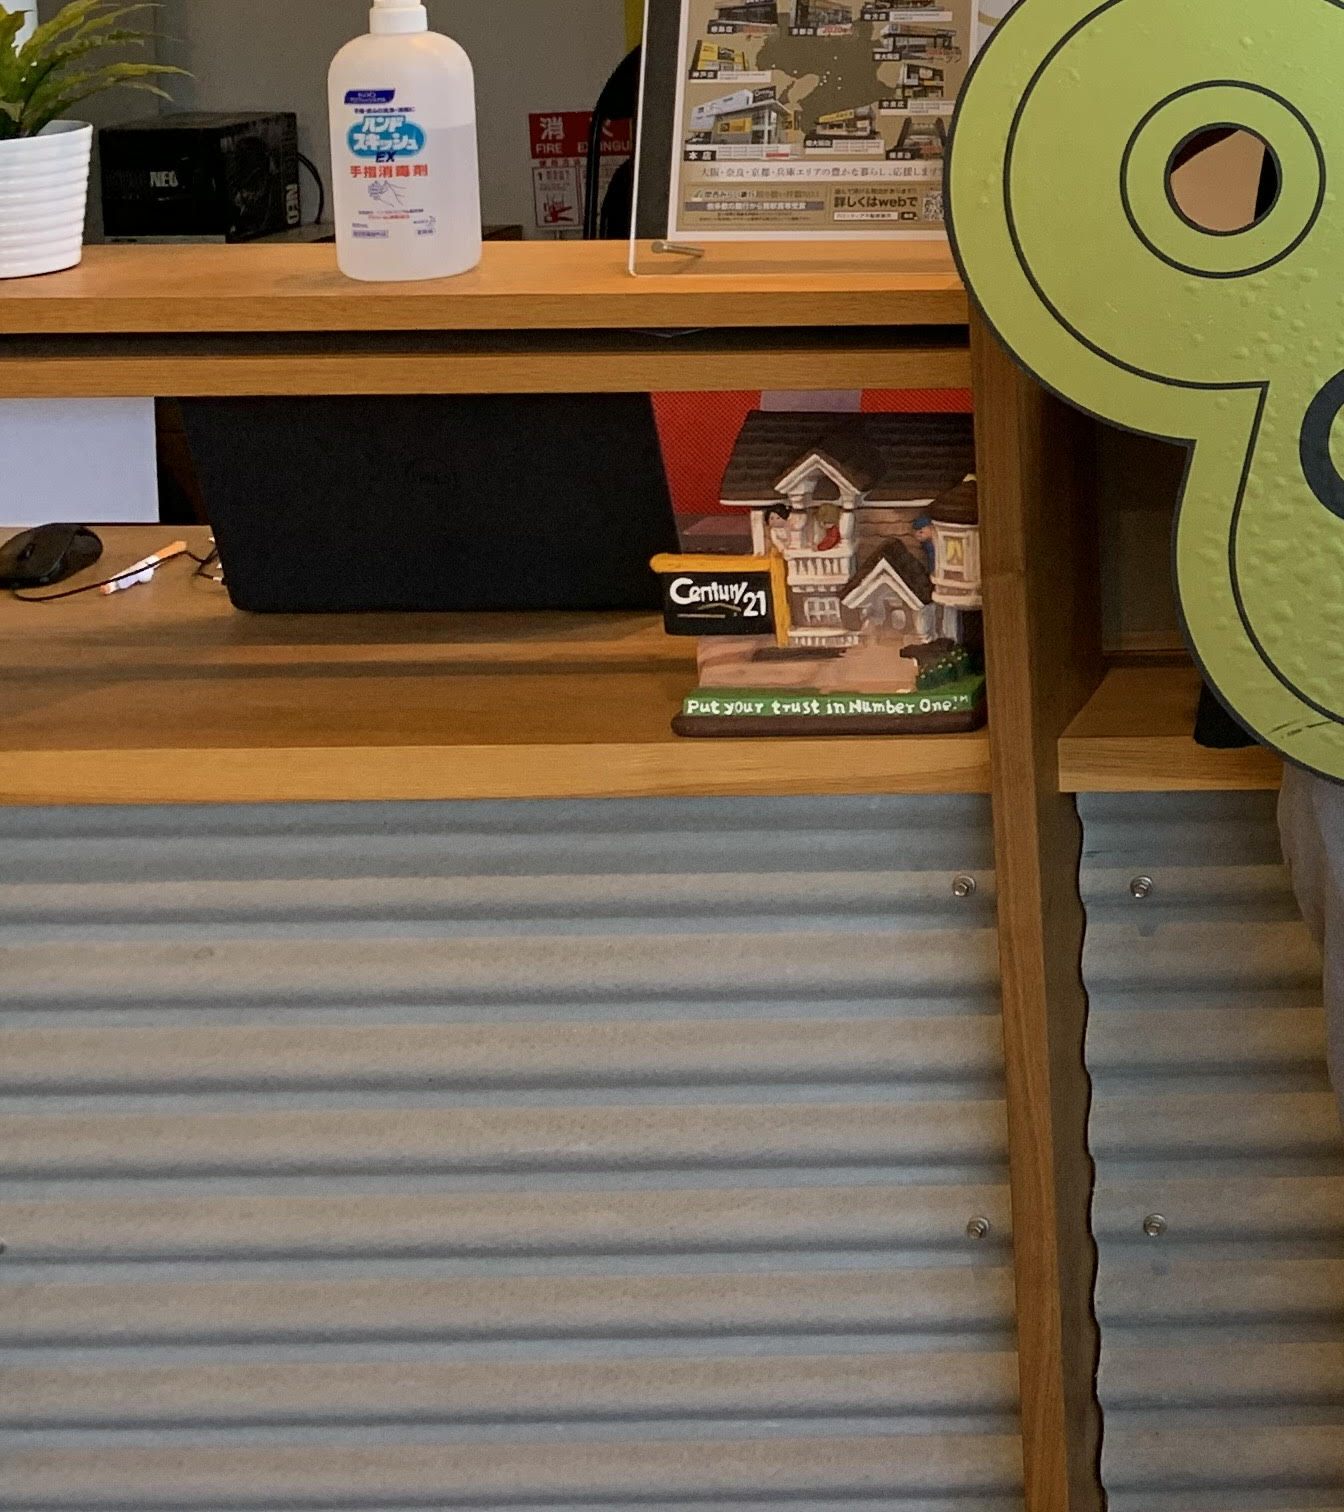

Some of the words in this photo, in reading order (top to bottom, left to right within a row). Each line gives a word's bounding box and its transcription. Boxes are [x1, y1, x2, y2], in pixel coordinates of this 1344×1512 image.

[361, 117, 404, 133] ハンド
[536, 143, 562, 154] FIRE
[375, 151, 396, 163] EX
[834, 195, 919, 208] 詳しくはwebで
[669, 577, 748, 605] Century
[743, 591, 767, 617] 21
[686, 700, 720, 714] Put
[724, 700, 764, 715] your
[772, 698, 820, 715] trust
[825, 698, 847, 714] in
[848, 698, 915, 714] Number
